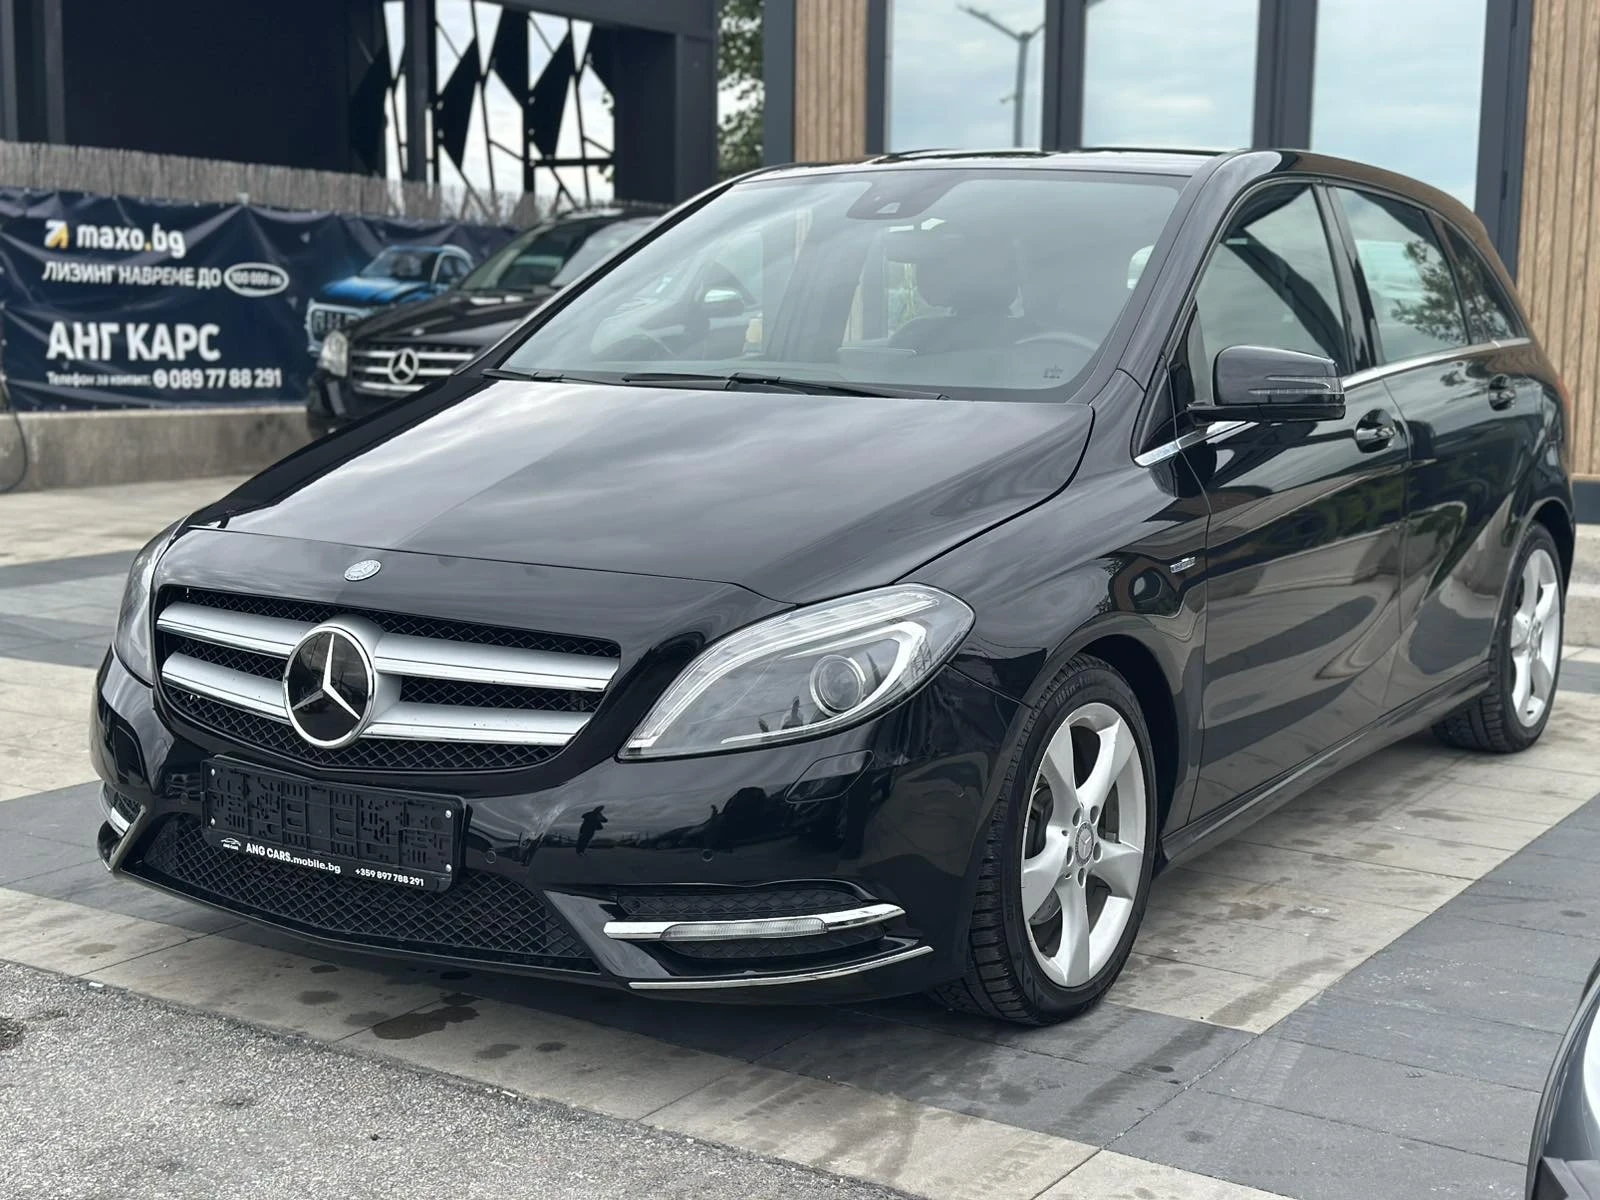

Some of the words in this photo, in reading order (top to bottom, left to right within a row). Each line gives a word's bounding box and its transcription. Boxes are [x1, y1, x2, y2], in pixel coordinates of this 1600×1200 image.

[76, 223, 186, 258] maxo.bg
[42, 261, 117, 283] ЛИЗИНГ
[118, 265, 195, 287] НАВРЕМЕ
[196, 267, 222, 290] ДО
[46, 322, 119, 360] АНГ
[126, 323, 221, 361] КАРС
[46, 371, 95, 388] Телефон
[169, 369, 203, 388] 089
[206, 368, 227, 388] 77
[228, 368, 251, 388] 88
[254, 368, 282, 388] 291
[245, 842, 265, 856] ANG
[355, 868, 376, 878] +359
[376, 870, 392, 881] 897
[393, 873, 409, 884] 788
[409, 876, 424, 887] 291
